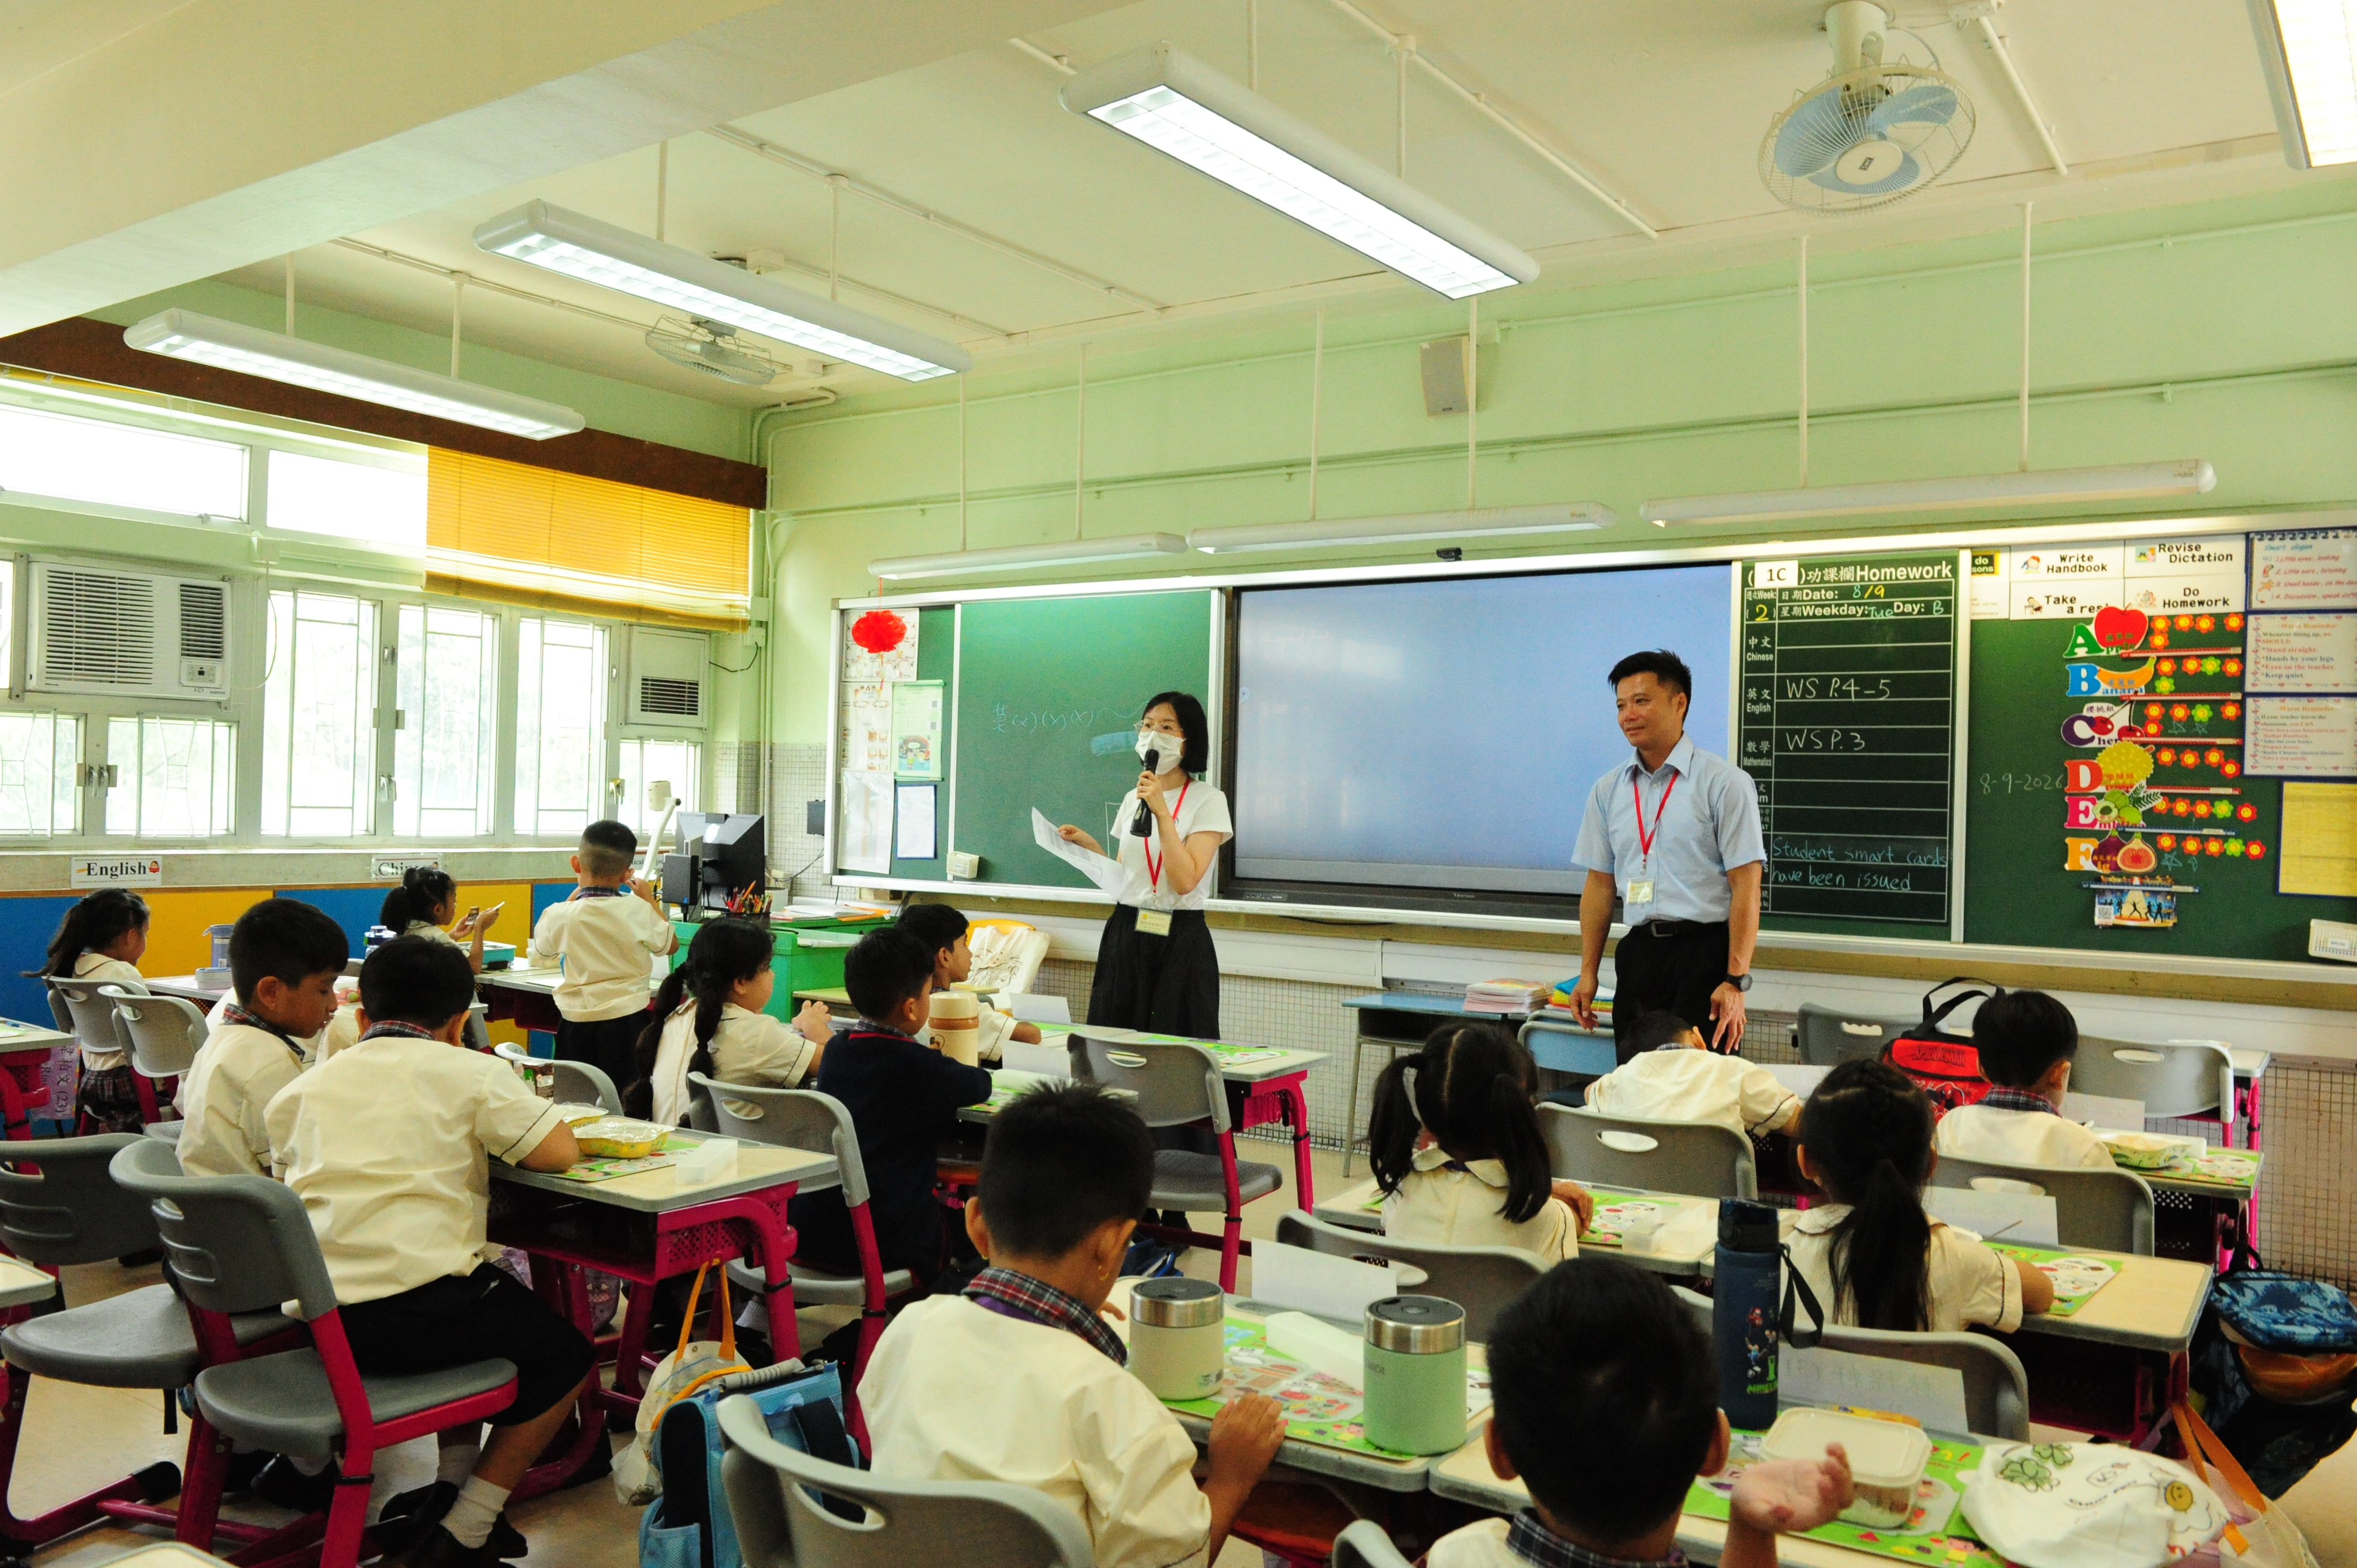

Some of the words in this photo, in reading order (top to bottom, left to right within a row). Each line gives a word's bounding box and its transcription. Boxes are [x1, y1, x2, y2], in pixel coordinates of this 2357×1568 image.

[2159, 544, 2201, 553] Revise
[1974, 556, 1989, 565] do
[2060, 554, 2093, 563] Write
[2169, 553, 2232, 564] Dictation
[1856, 561, 1952, 581] Homework
[2047, 564, 2107, 574] Handbook
[1803, 589, 1839, 601] Date:
[2183, 587, 2200, 596] Do
[2045, 595, 2077, 605] Take
[2163, 597, 2230, 608] Homework
[1802, 603, 1868, 617] Weekday:
[1869, 606, 1895, 618] Tue
[1894, 601, 1925, 615] Day:
[1932, 600, 1944, 615] B
[2080, 604, 2108, 613] res
[1748, 636, 1772, 649] 中文
[1747, 652, 1773, 662] Chinese
[1747, 687, 1772, 700] 英文
[1786, 677, 1819, 699] WS
[1747, 703, 1771, 714] English
[2062, 715, 2119, 746] Cher
[1786, 728, 1823, 750] WS
[1746, 740, 1771, 754] 數學
[1743, 757, 1772, 767] Mathematics
[1773, 837, 1836, 862] Student
[1845, 845, 1894, 864] smart
[86, 862, 146, 879] English
[1772, 865, 1802, 883] have
[1809, 865, 1845, 886] been
[1857, 872, 1911, 891] issued
